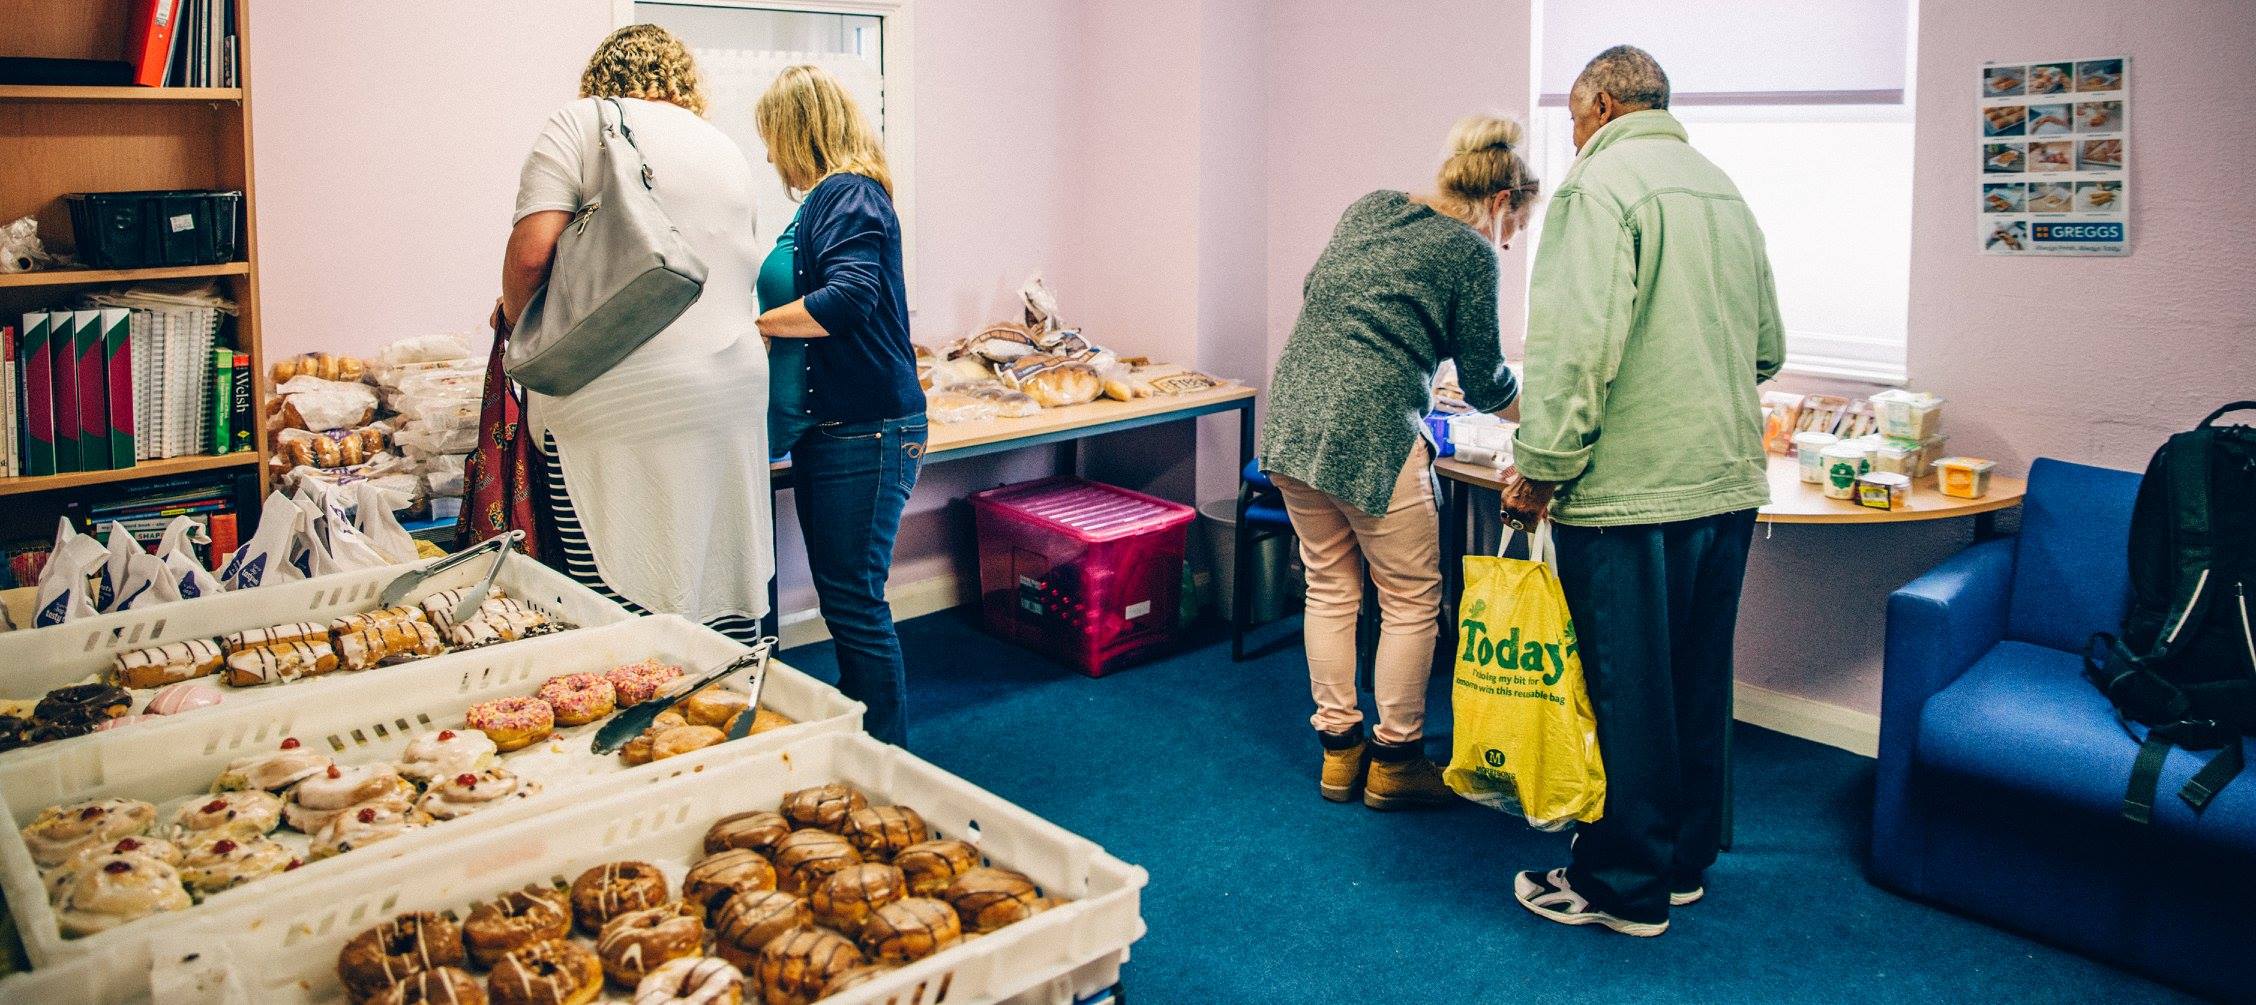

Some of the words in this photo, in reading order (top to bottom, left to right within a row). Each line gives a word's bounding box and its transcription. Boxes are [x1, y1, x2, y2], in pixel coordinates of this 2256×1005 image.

[2052, 226, 2119, 238] GREGGS
[236, 371, 249, 413] Welsh
[1461, 618, 1564, 686] Today
[1498, 675, 1512, 685] my
[1514, 675, 1526, 685] bit
[1528, 677, 1540, 685] for
[1497, 687, 1512, 697] this
[1514, 689, 1548, 700] reusable
[1550, 693, 1566, 706] bag
[1489, 750, 1502, 765] M
